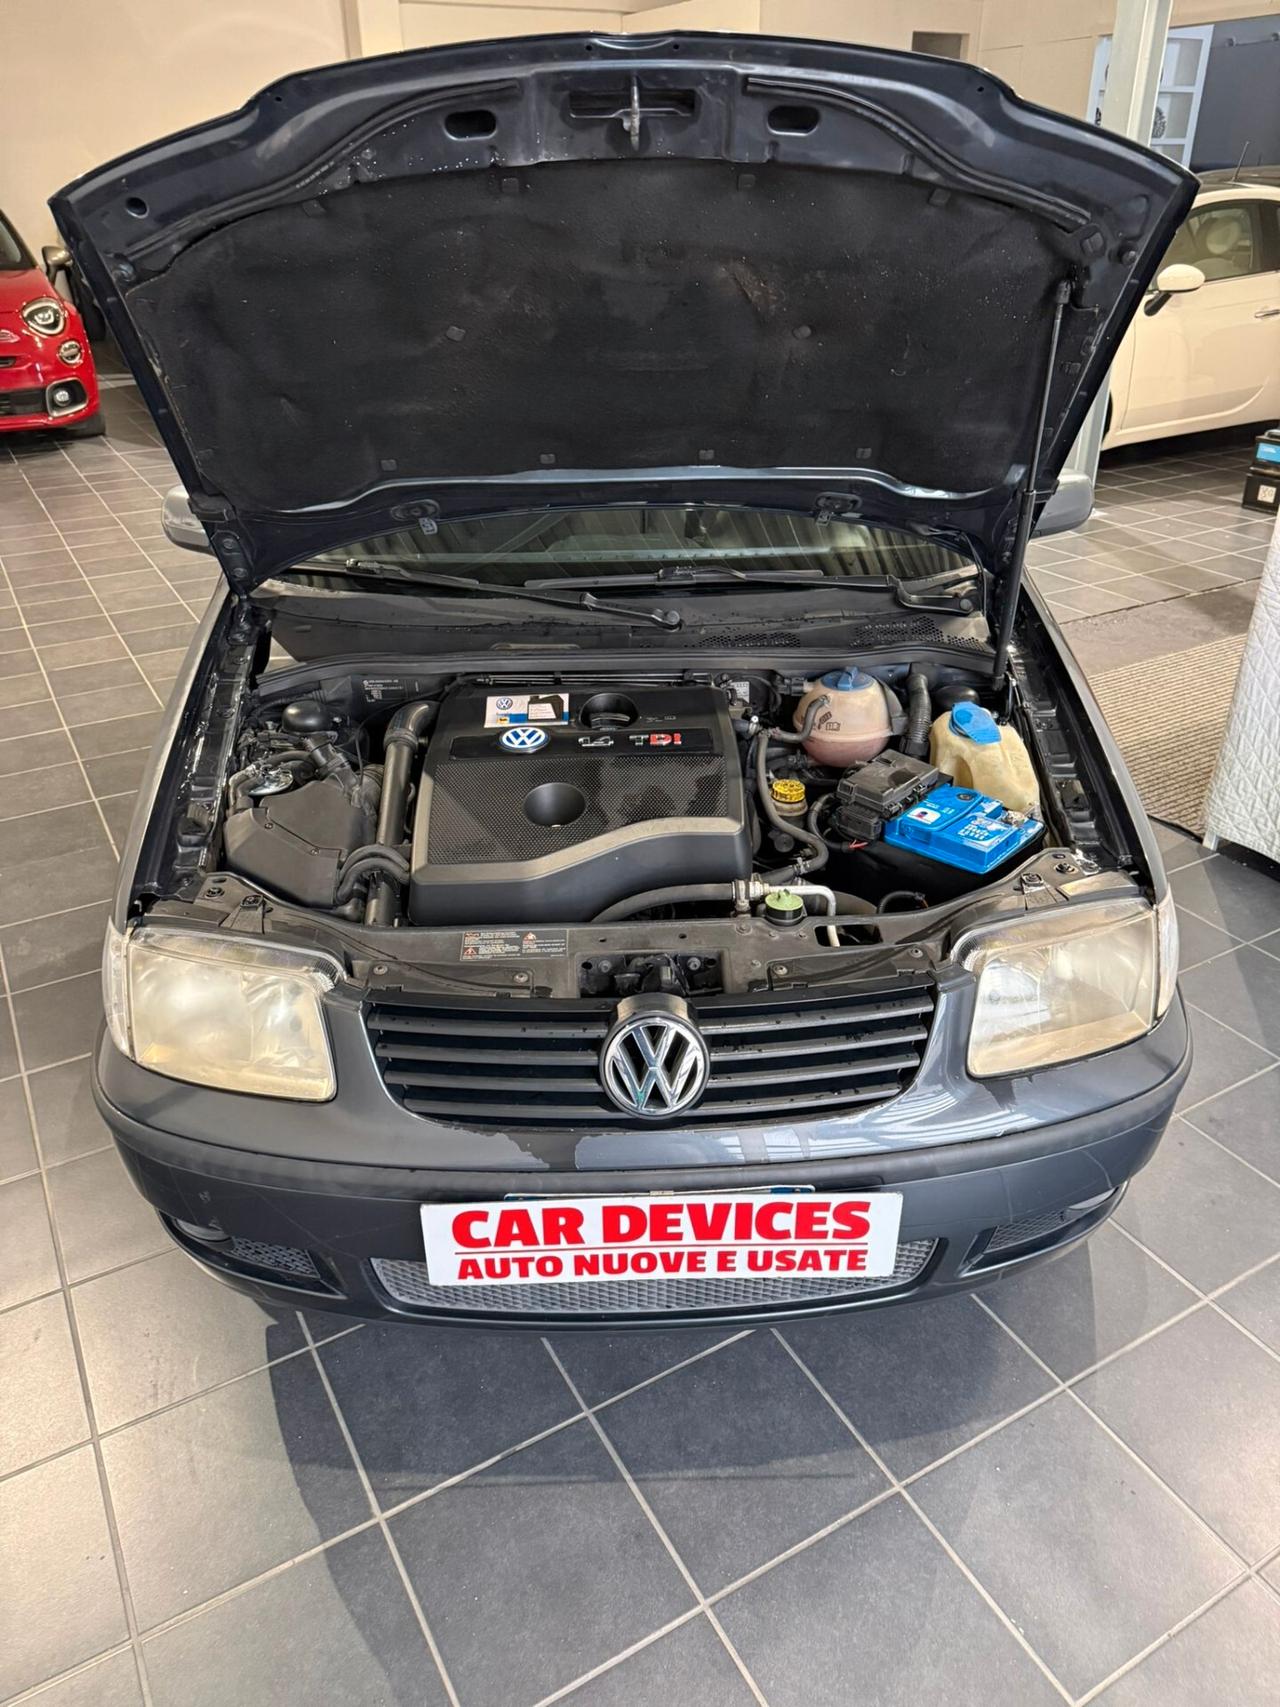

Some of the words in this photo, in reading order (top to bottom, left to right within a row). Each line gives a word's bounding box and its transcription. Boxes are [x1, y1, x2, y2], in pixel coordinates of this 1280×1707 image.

[501, 726, 547, 749] VW
[629, 732, 682, 746] TDI
[604, 1016, 705, 1117] VW
[451, 1207, 585, 1249] CAR
[602, 1201, 871, 1244] DEVICES
[458, 1255, 563, 1280] AUTO
[574, 1251, 707, 1276] NUOVE
[717, 1250, 737, 1272] E
[747, 1249, 868, 1272] USATE
